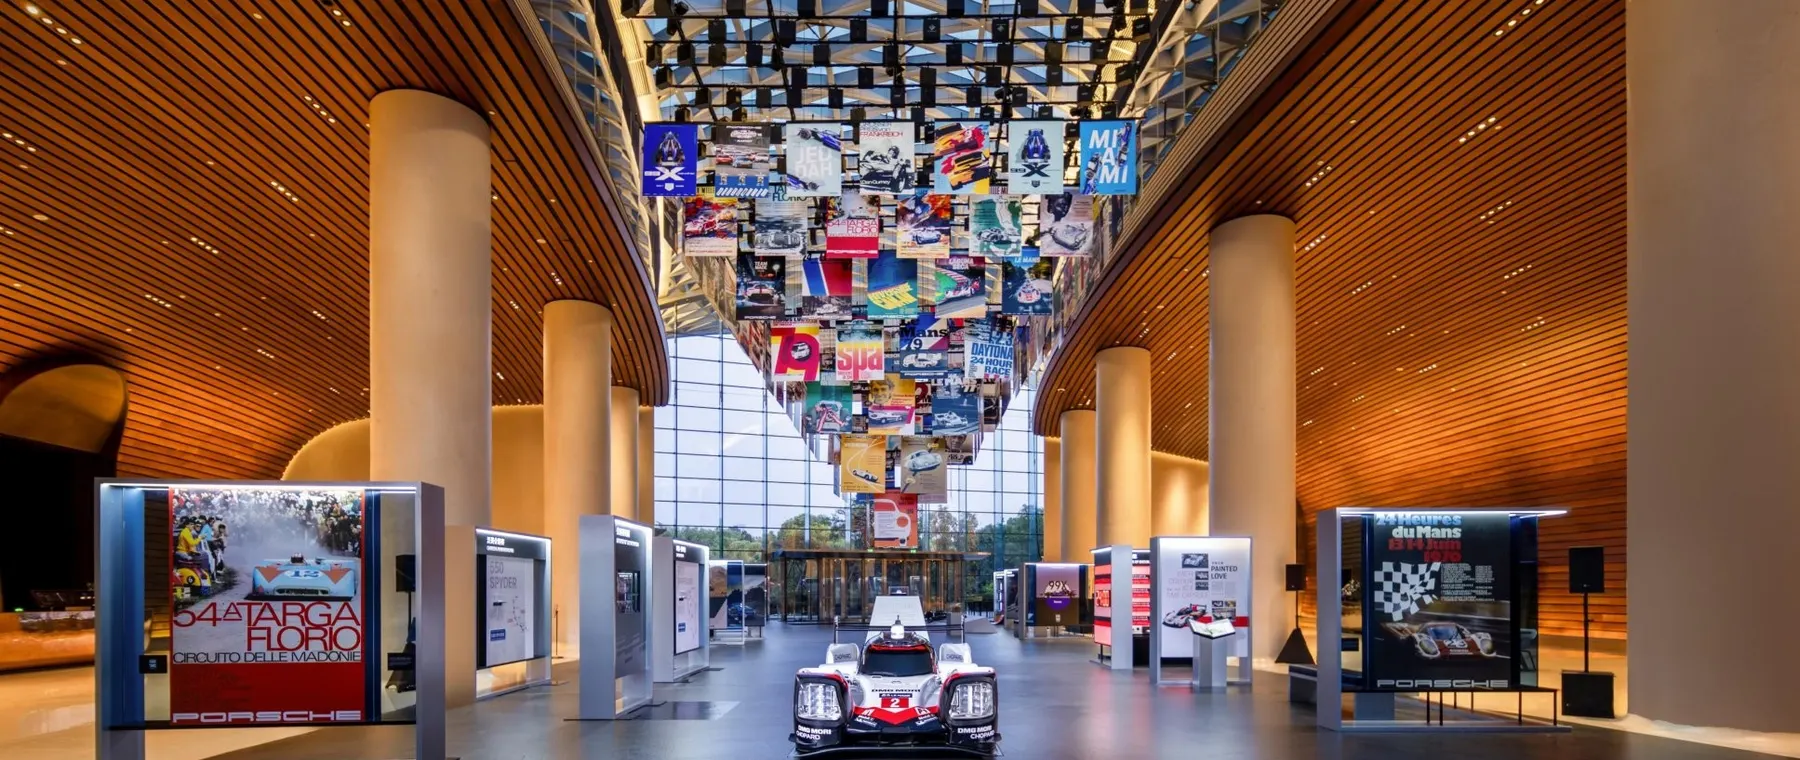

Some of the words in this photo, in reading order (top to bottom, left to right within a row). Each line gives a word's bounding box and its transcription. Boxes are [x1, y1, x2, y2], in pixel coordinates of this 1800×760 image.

[1088, 129, 1118, 149] MI
[1101, 147, 1116, 166] A
[1099, 165, 1128, 184] MI
[971, 343, 1013, 360] DAYTONA
[837, 345, 883, 381] spa
[970, 356, 984, 364] 24
[985, 358, 1013, 368] HOUR
[984, 366, 1011, 376] RACE
[1376, 513, 1398, 526] 24
[1398, 514, 1462, 526] Heures
[1392, 526, 1415, 538] du
[1416, 526, 1462, 538] Mans
[1424, 551, 1462, 562] 1970
[490, 577, 518, 589] SPYDER
[236, 600, 361, 628] TARGA
[247, 626, 361, 652] FLORIO
[173, 652, 241, 664] CIRCUITO
[244, 652, 288, 662] DELLE
[291, 651, 361, 662] MADONIE
[1376, 680, 1508, 688] PORSCHE
[890, 698, 900, 708] 2
[172, 710, 361, 723] PORSCHE
